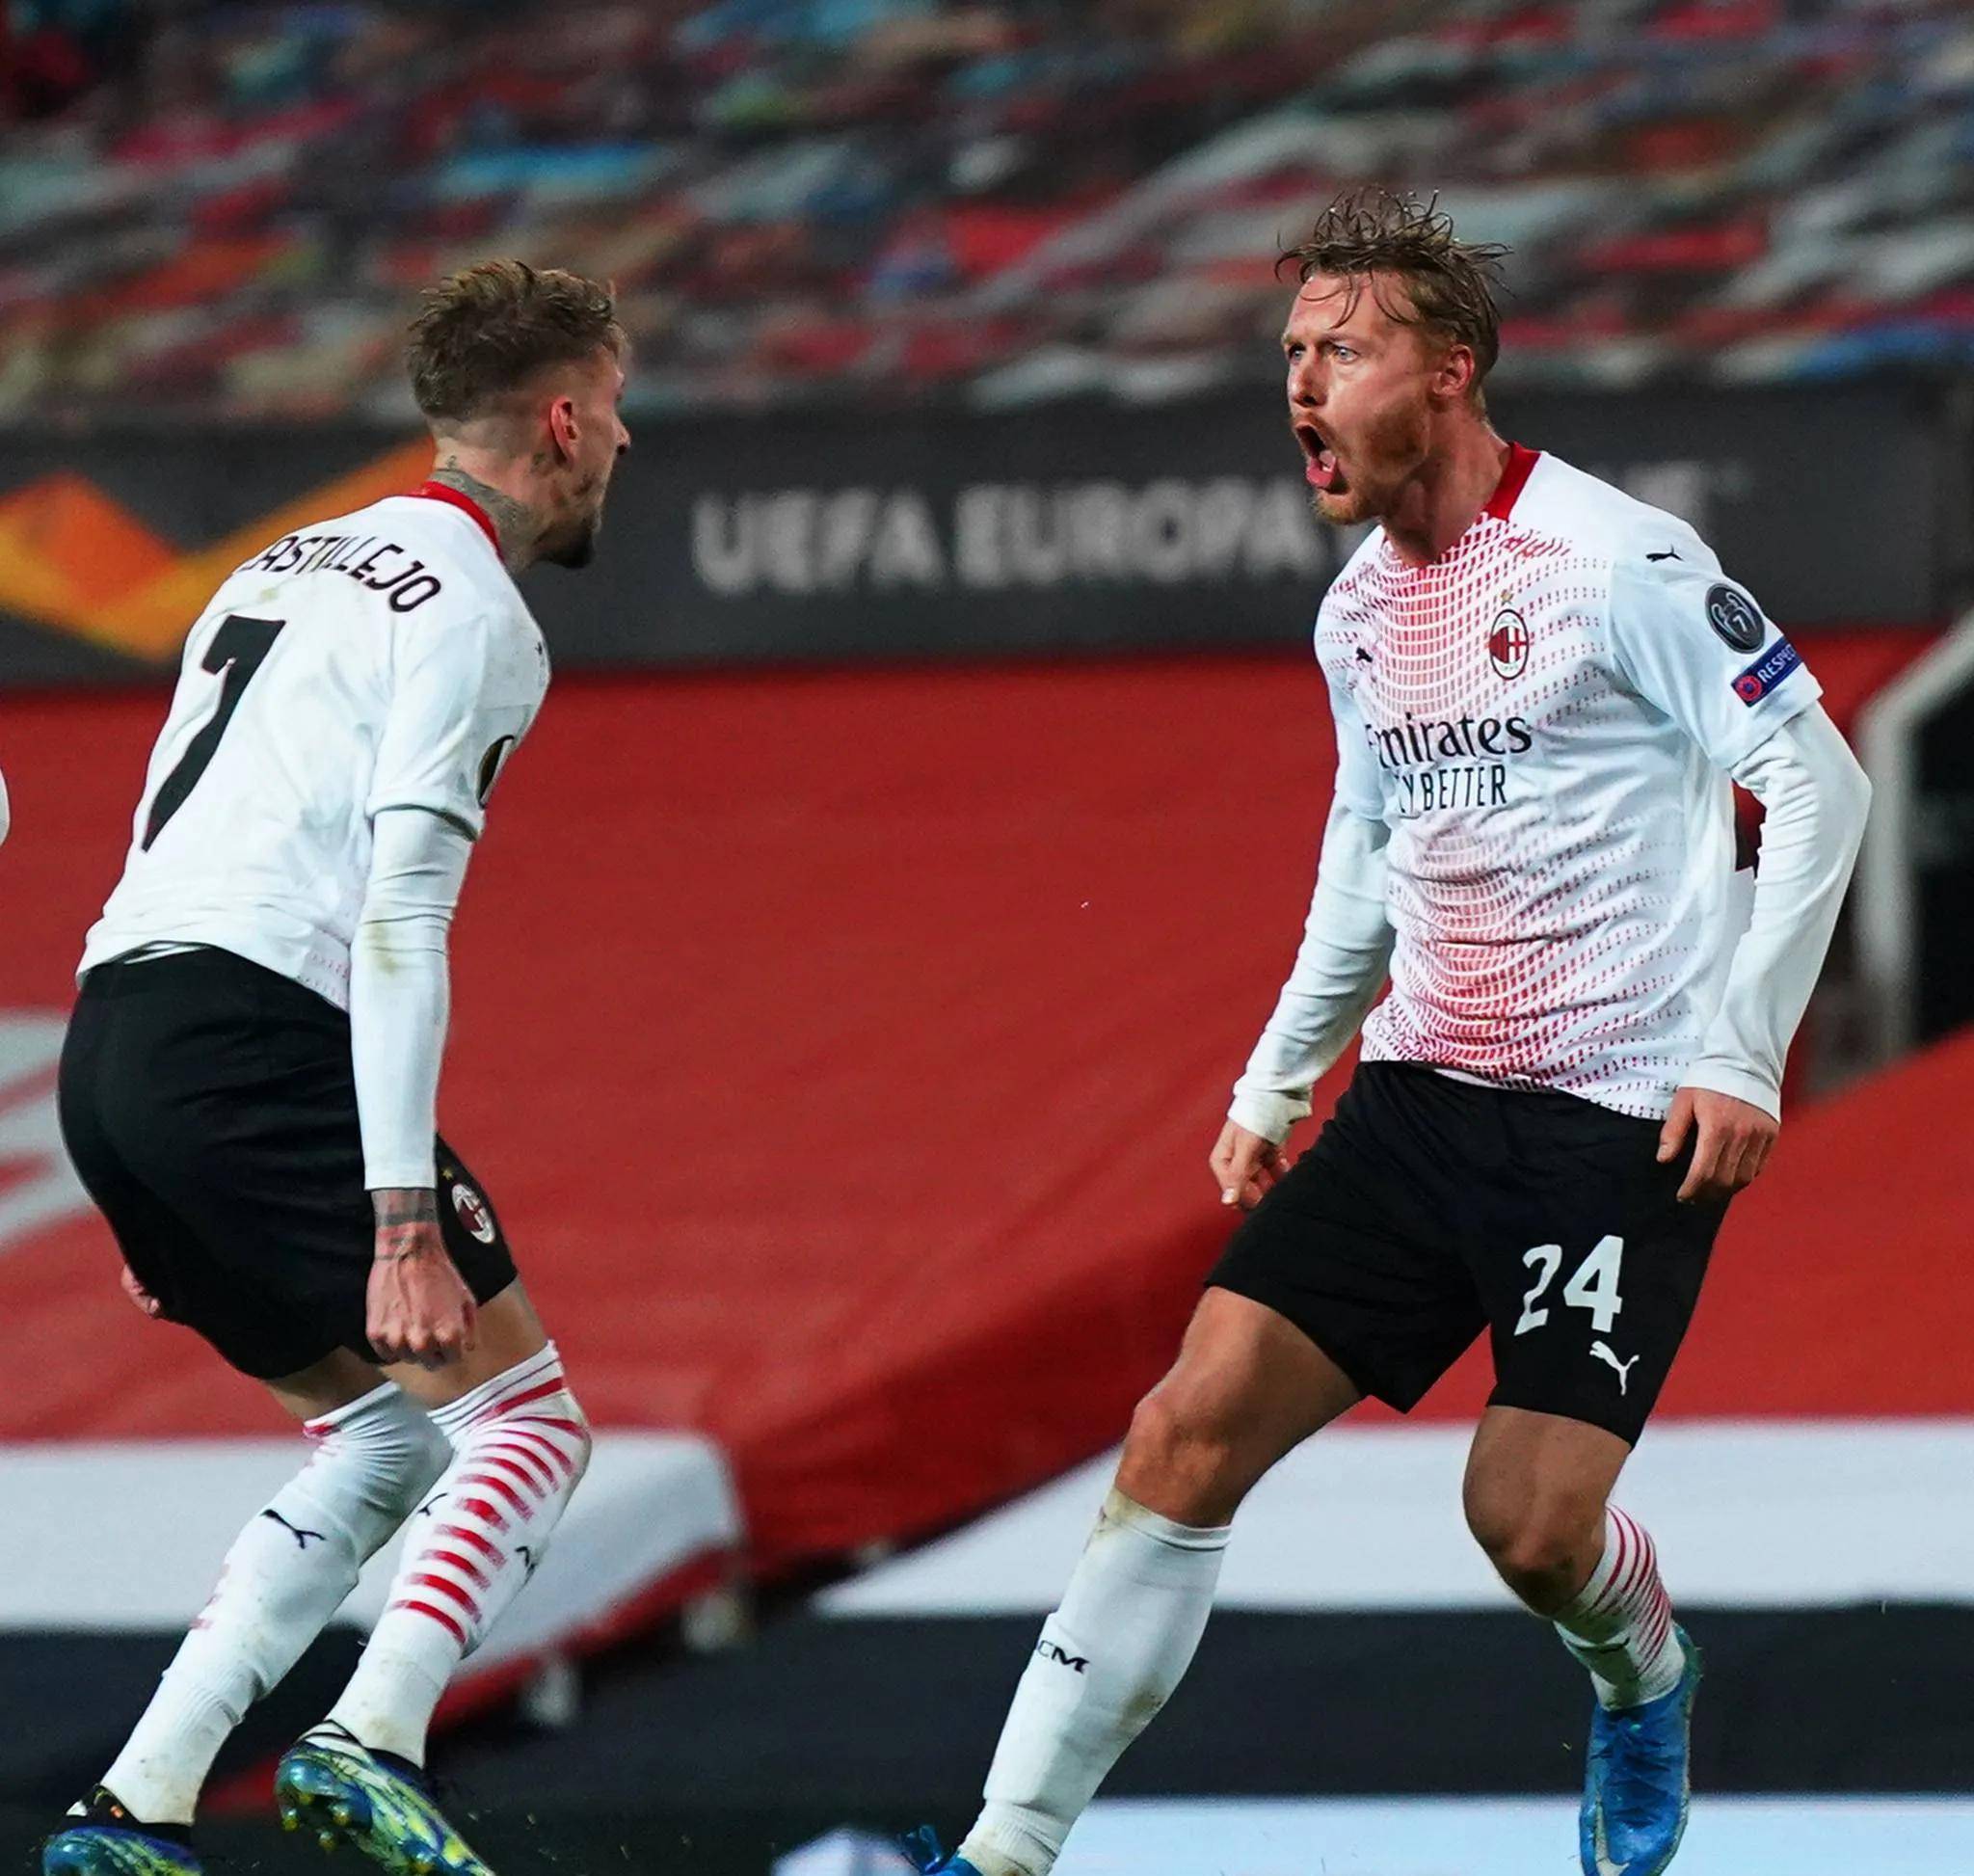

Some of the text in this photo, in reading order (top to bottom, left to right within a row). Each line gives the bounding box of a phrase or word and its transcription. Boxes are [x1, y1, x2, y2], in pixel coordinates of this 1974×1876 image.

[237, 536, 441, 613] ASTILLEJO
[692, 488, 947, 594] UEFA
[956, 479, 1320, 585] EUROPA
[142, 614, 286, 853] 7
[1420, 764, 1507, 812] BETTER
[1513, 1234, 1624, 1336] 24
